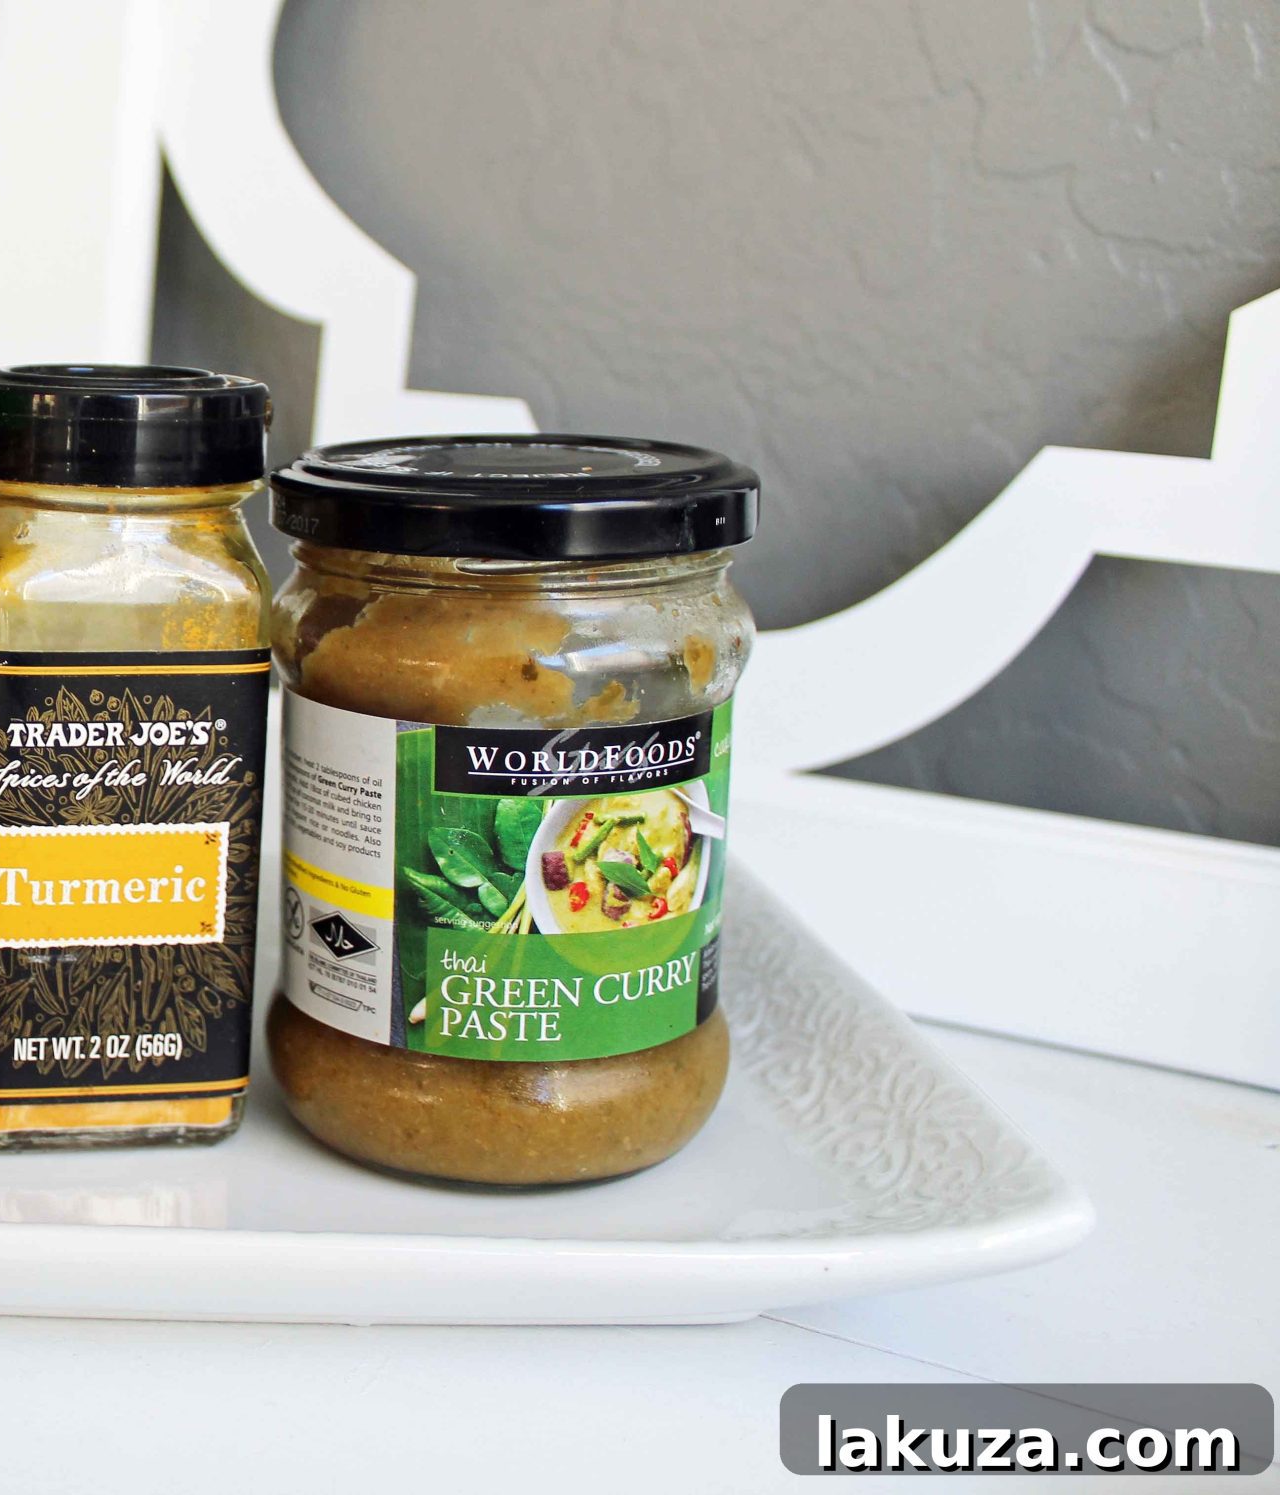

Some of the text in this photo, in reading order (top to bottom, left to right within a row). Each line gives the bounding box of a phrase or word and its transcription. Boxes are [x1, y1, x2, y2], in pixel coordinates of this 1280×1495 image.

[7, 721, 124, 748] TRADER
[72, 760, 118, 801] of
[104, 760, 148, 787] the
[160, 757, 243, 787] World
[321, 765, 360, 782] tablespoons
[362, 776, 370, 784] of
[372, 779, 382, 787] oil
[511, 769, 669, 787] FUSION OF FLAVORS
[318, 776, 336, 788] Green
[338, 782, 357, 795] Curry
[360, 787, 382, 799] Paste
[330, 792, 351, 804] cubed
[353, 799, 382, 811] chicken
[337, 805, 349, 815] and
[351, 809, 371, 822] bring
[373, 814, 381, 823] to
[341, 818, 357, 828] until
[360, 824, 382, 834] sauce
[348, 844, 381, 858] products
[364, 836, 381, 846] Also
[434, 916, 468, 929] serving
[440, 949, 488, 974] thai
[440, 974, 583, 1008] GREEN
[593, 951, 697, 1006] CURRY
[439, 1006, 562, 1042] PASTE
[13, 1033, 183, 1061] NET WT. 2 OZ (56G)
